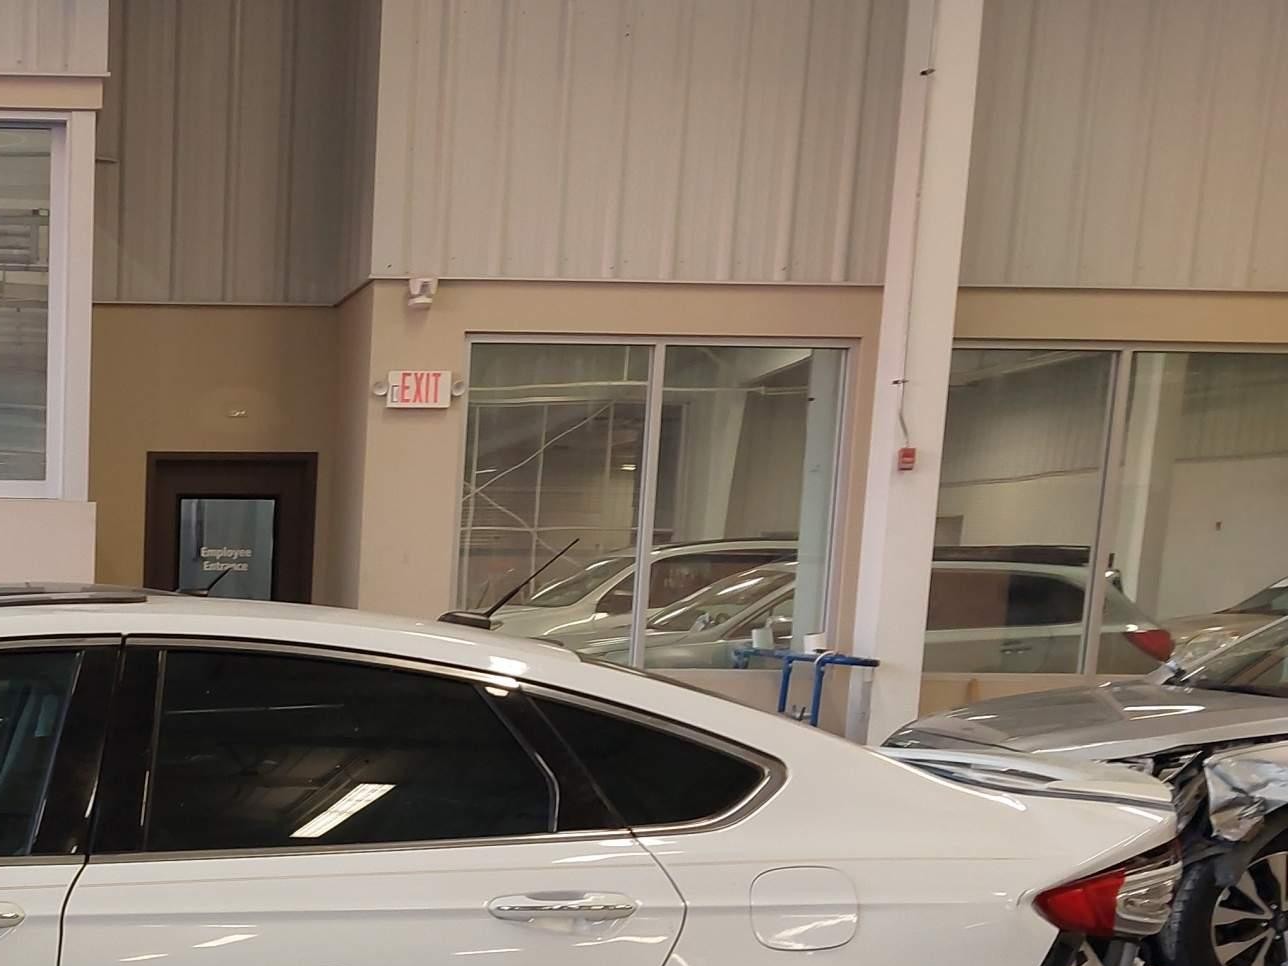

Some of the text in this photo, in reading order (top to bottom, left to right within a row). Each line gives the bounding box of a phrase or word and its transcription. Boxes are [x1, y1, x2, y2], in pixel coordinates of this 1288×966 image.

[400, 372, 441, 403] EXIT
[201, 546, 252, 560] Employee
[203, 561, 248, 571] Entrance
